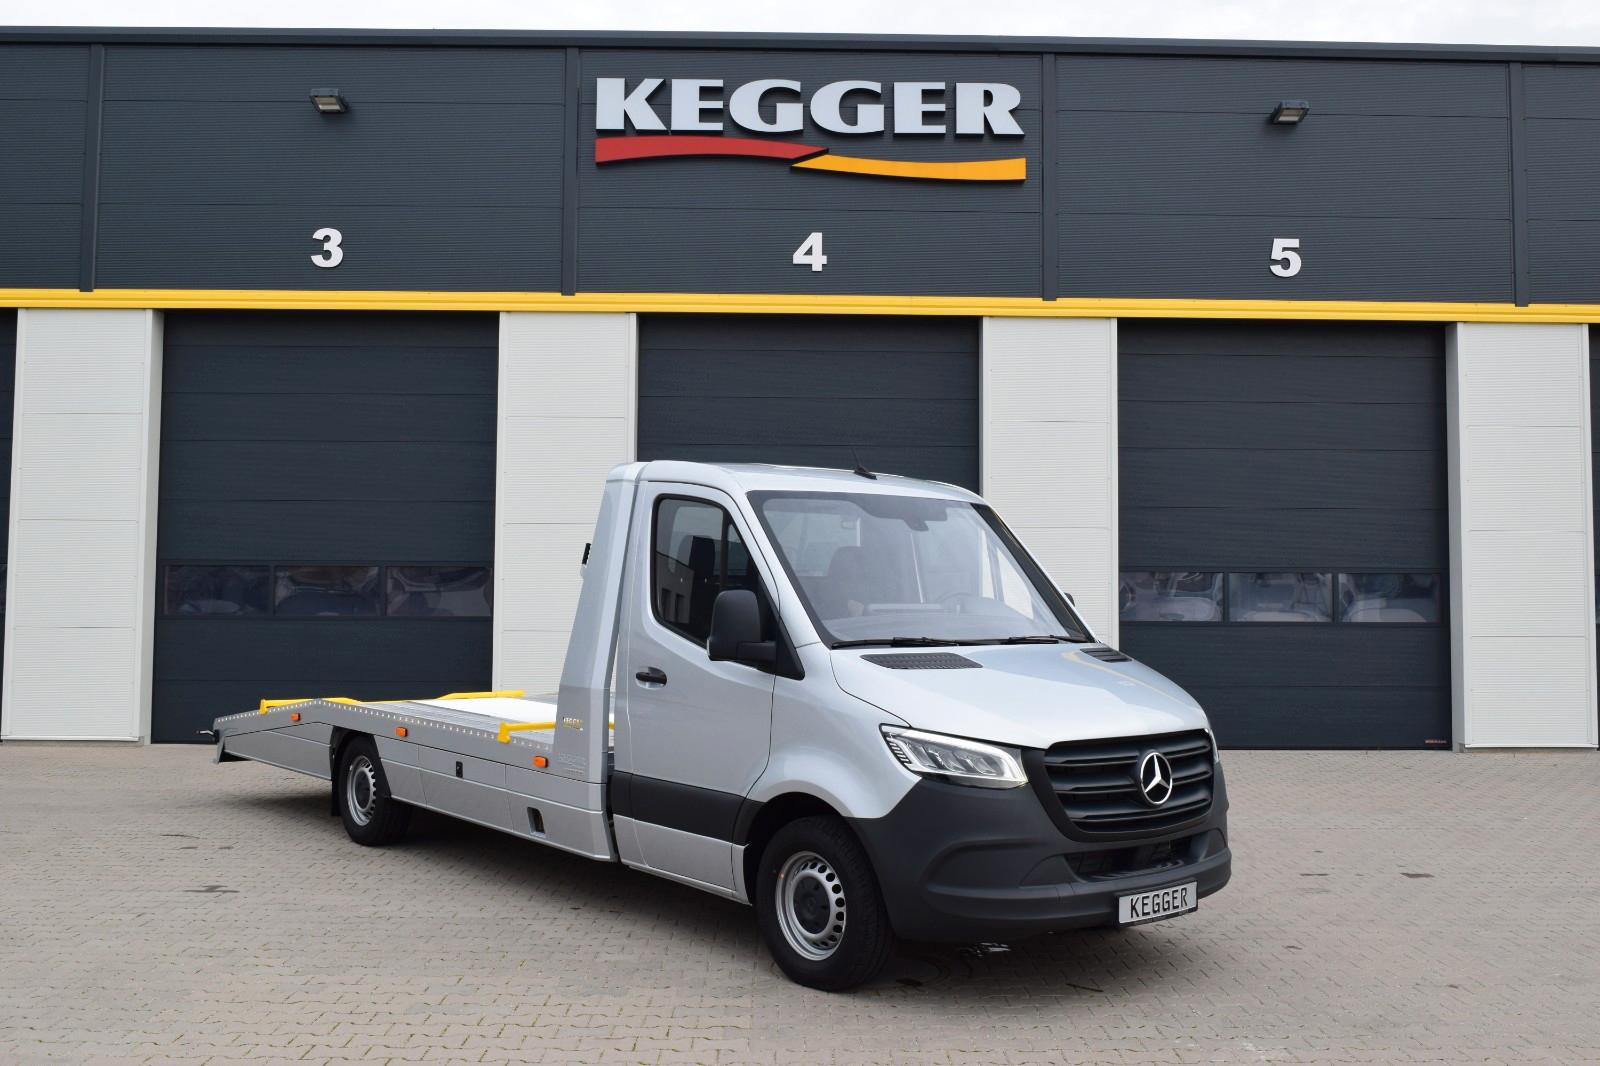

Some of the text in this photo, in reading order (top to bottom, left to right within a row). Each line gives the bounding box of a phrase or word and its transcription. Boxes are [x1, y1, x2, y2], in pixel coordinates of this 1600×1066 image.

[595, 77, 1025, 136] KEGGER
[311, 228, 344, 268] 3
[793, 232, 828, 272] 4
[1270, 239, 1303, 278] 5
[1130, 887, 1188, 919] KEGGER
